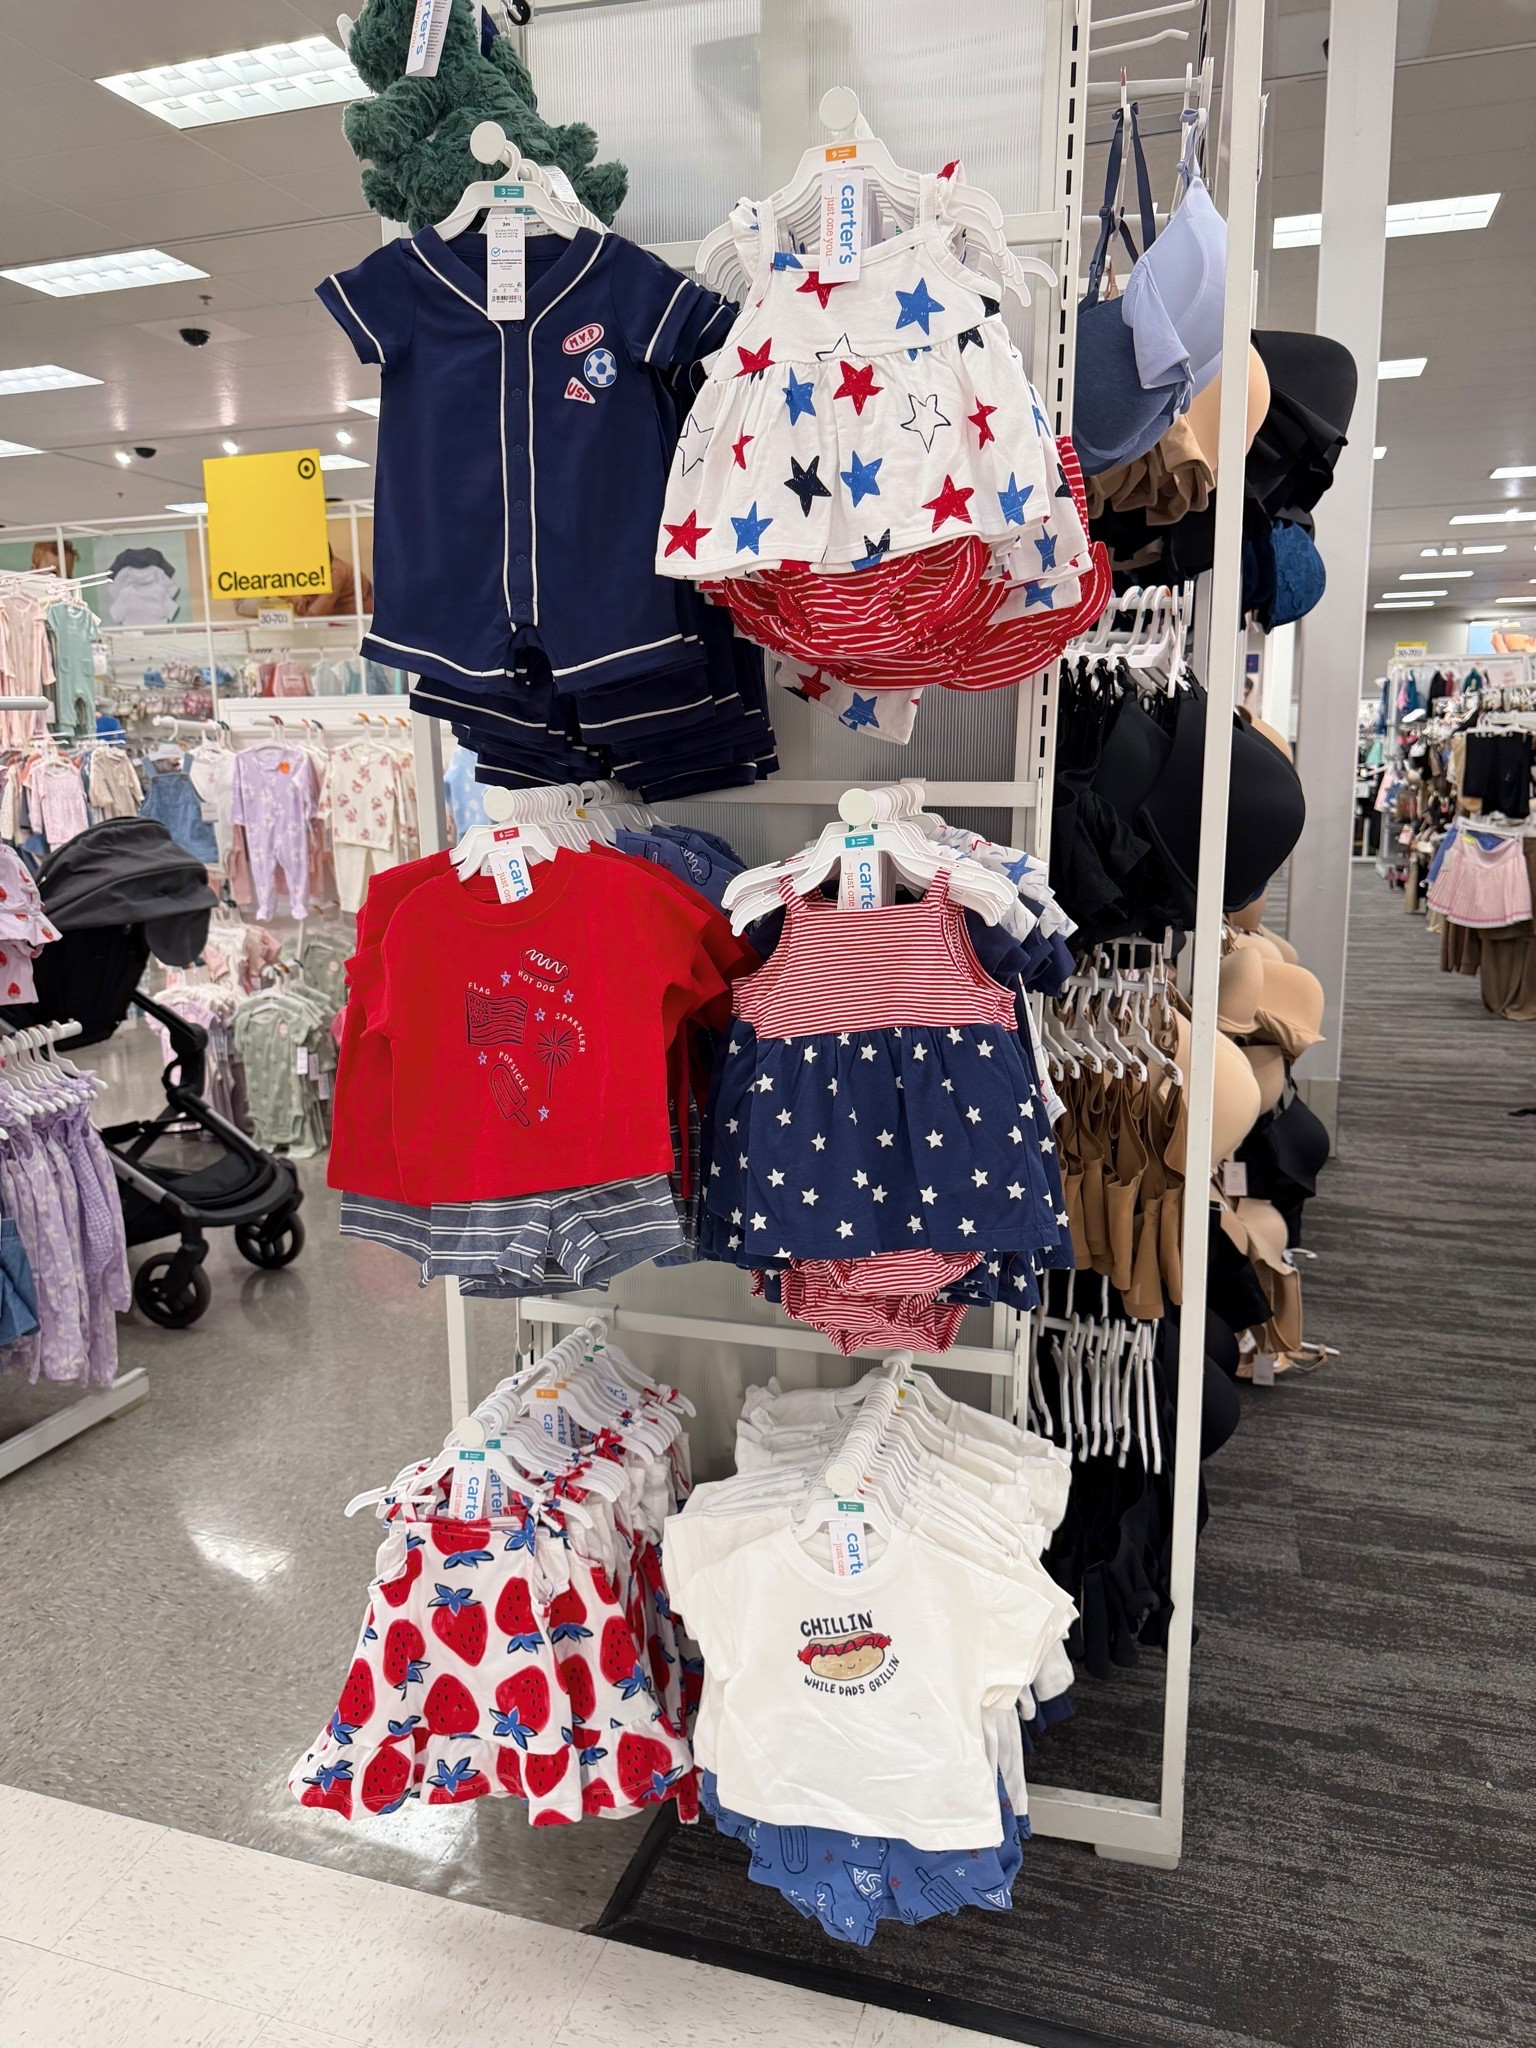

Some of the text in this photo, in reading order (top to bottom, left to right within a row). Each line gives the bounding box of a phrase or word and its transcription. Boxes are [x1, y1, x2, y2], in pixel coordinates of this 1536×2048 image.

[416, 0, 431, 55] rter's
[823, 196, 837, 257] just one you
[839, 184, 857, 265] carter's
[566, 382, 590, 401] USA
[218, 566, 326, 591] Clearance!
[497, 871, 507, 888] just
[844, 872, 855, 886] just
[468, 982, 490, 995] FLAG
[518, 970, 555, 993] HOT DOG
[555, 1012, 585, 1053] SPARKLER
[499, 1052, 529, 1092] POPSICLE
[490, 1469, 504, 1515] arter
[833, 1542, 843, 1558] just
[800, 1609, 872, 1637] CHILLIN'
[804, 1675, 836, 1693] WHILE
